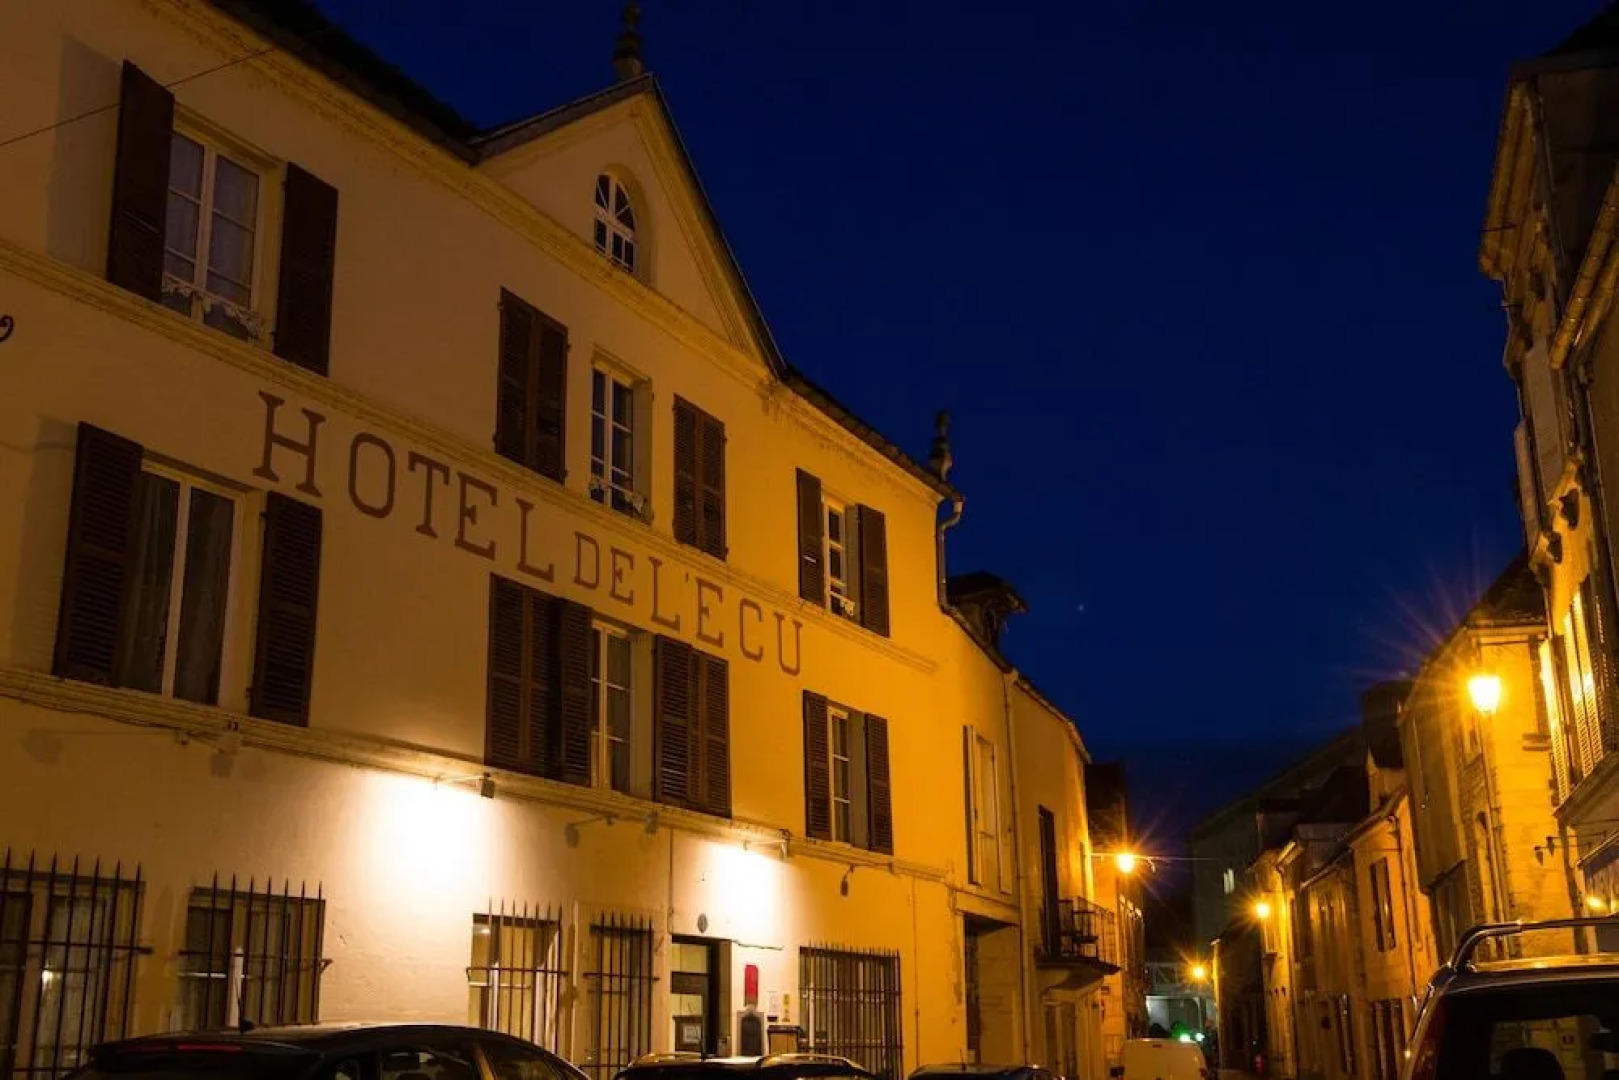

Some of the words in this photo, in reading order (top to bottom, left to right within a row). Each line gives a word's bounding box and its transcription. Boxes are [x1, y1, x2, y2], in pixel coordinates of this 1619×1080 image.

[253, 390, 555, 583] HOTEL
[573, 531, 635, 606] DE
[648, 557, 804, 677] L'ECU
